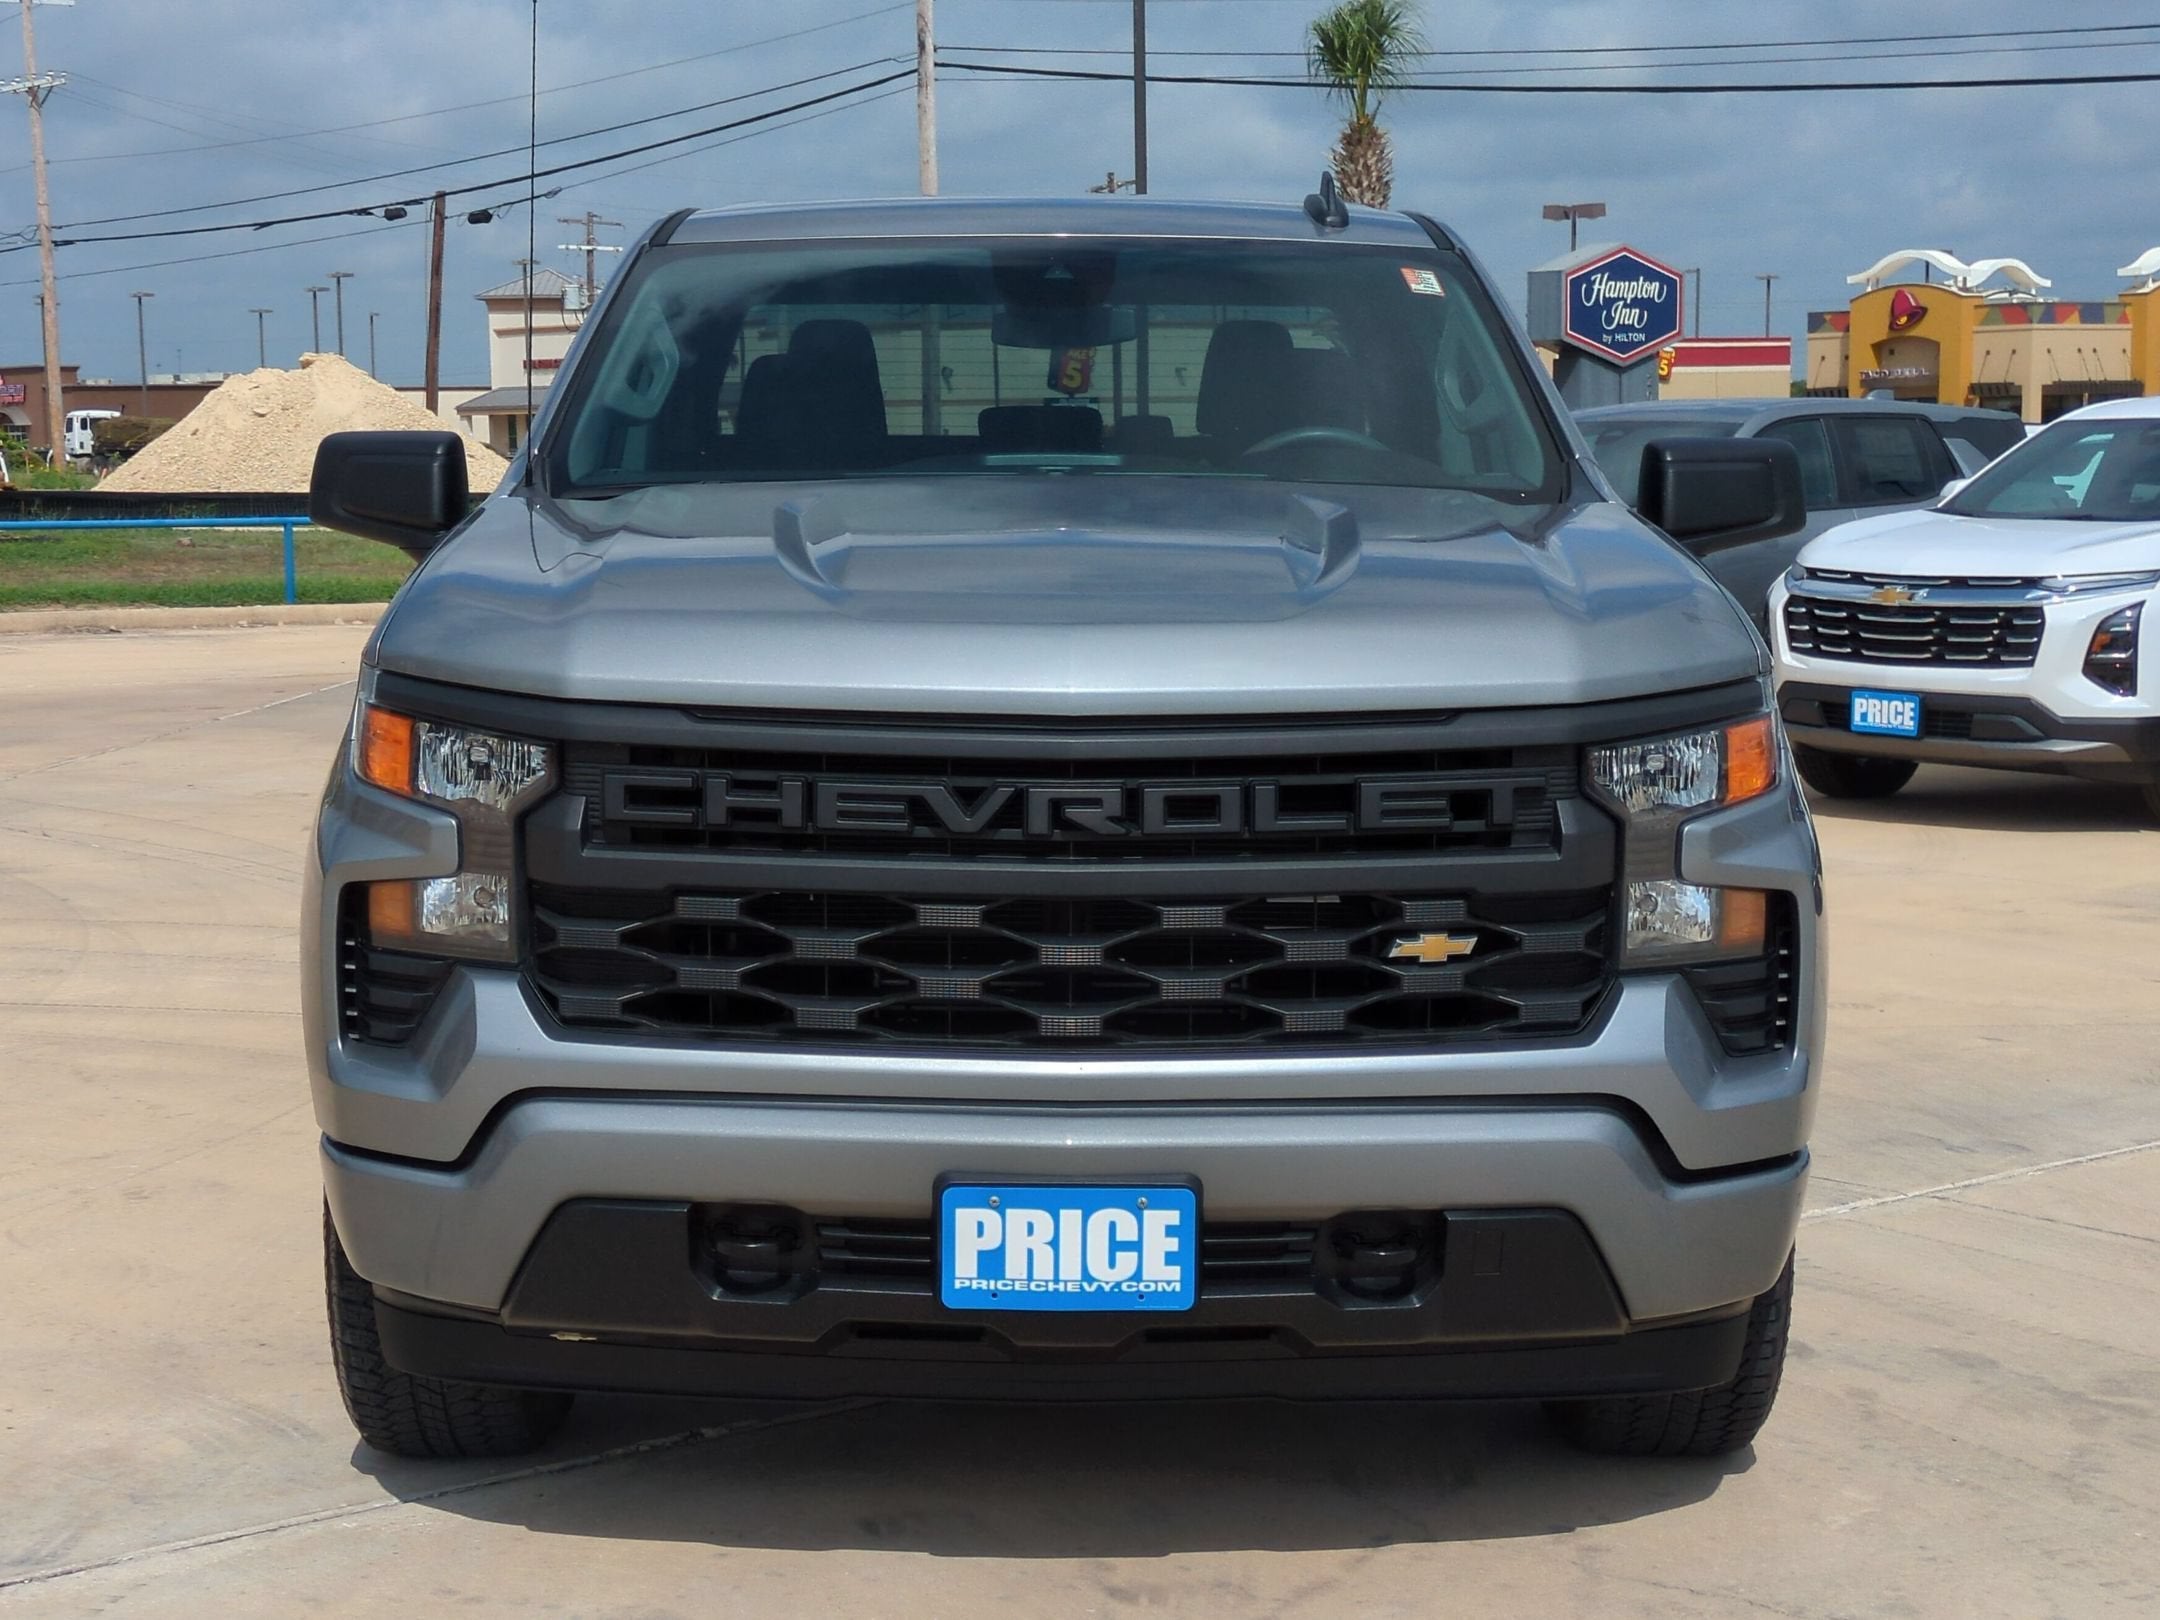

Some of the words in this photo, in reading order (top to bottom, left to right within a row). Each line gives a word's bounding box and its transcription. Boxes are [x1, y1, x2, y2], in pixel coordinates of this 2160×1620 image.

[1581, 271, 1667, 307] Hampton
[1601, 300, 1648, 330] Inn
[1602, 333, 1613, 345] by
[1614, 333, 1646, 343] HILTON
[1854, 697, 1916, 727] PRICE
[602, 770, 1549, 838] CHEVROLET
[954, 1207, 1182, 1283] PRICE
[953, 1278, 1182, 1293] PRICECHEVY.COM
